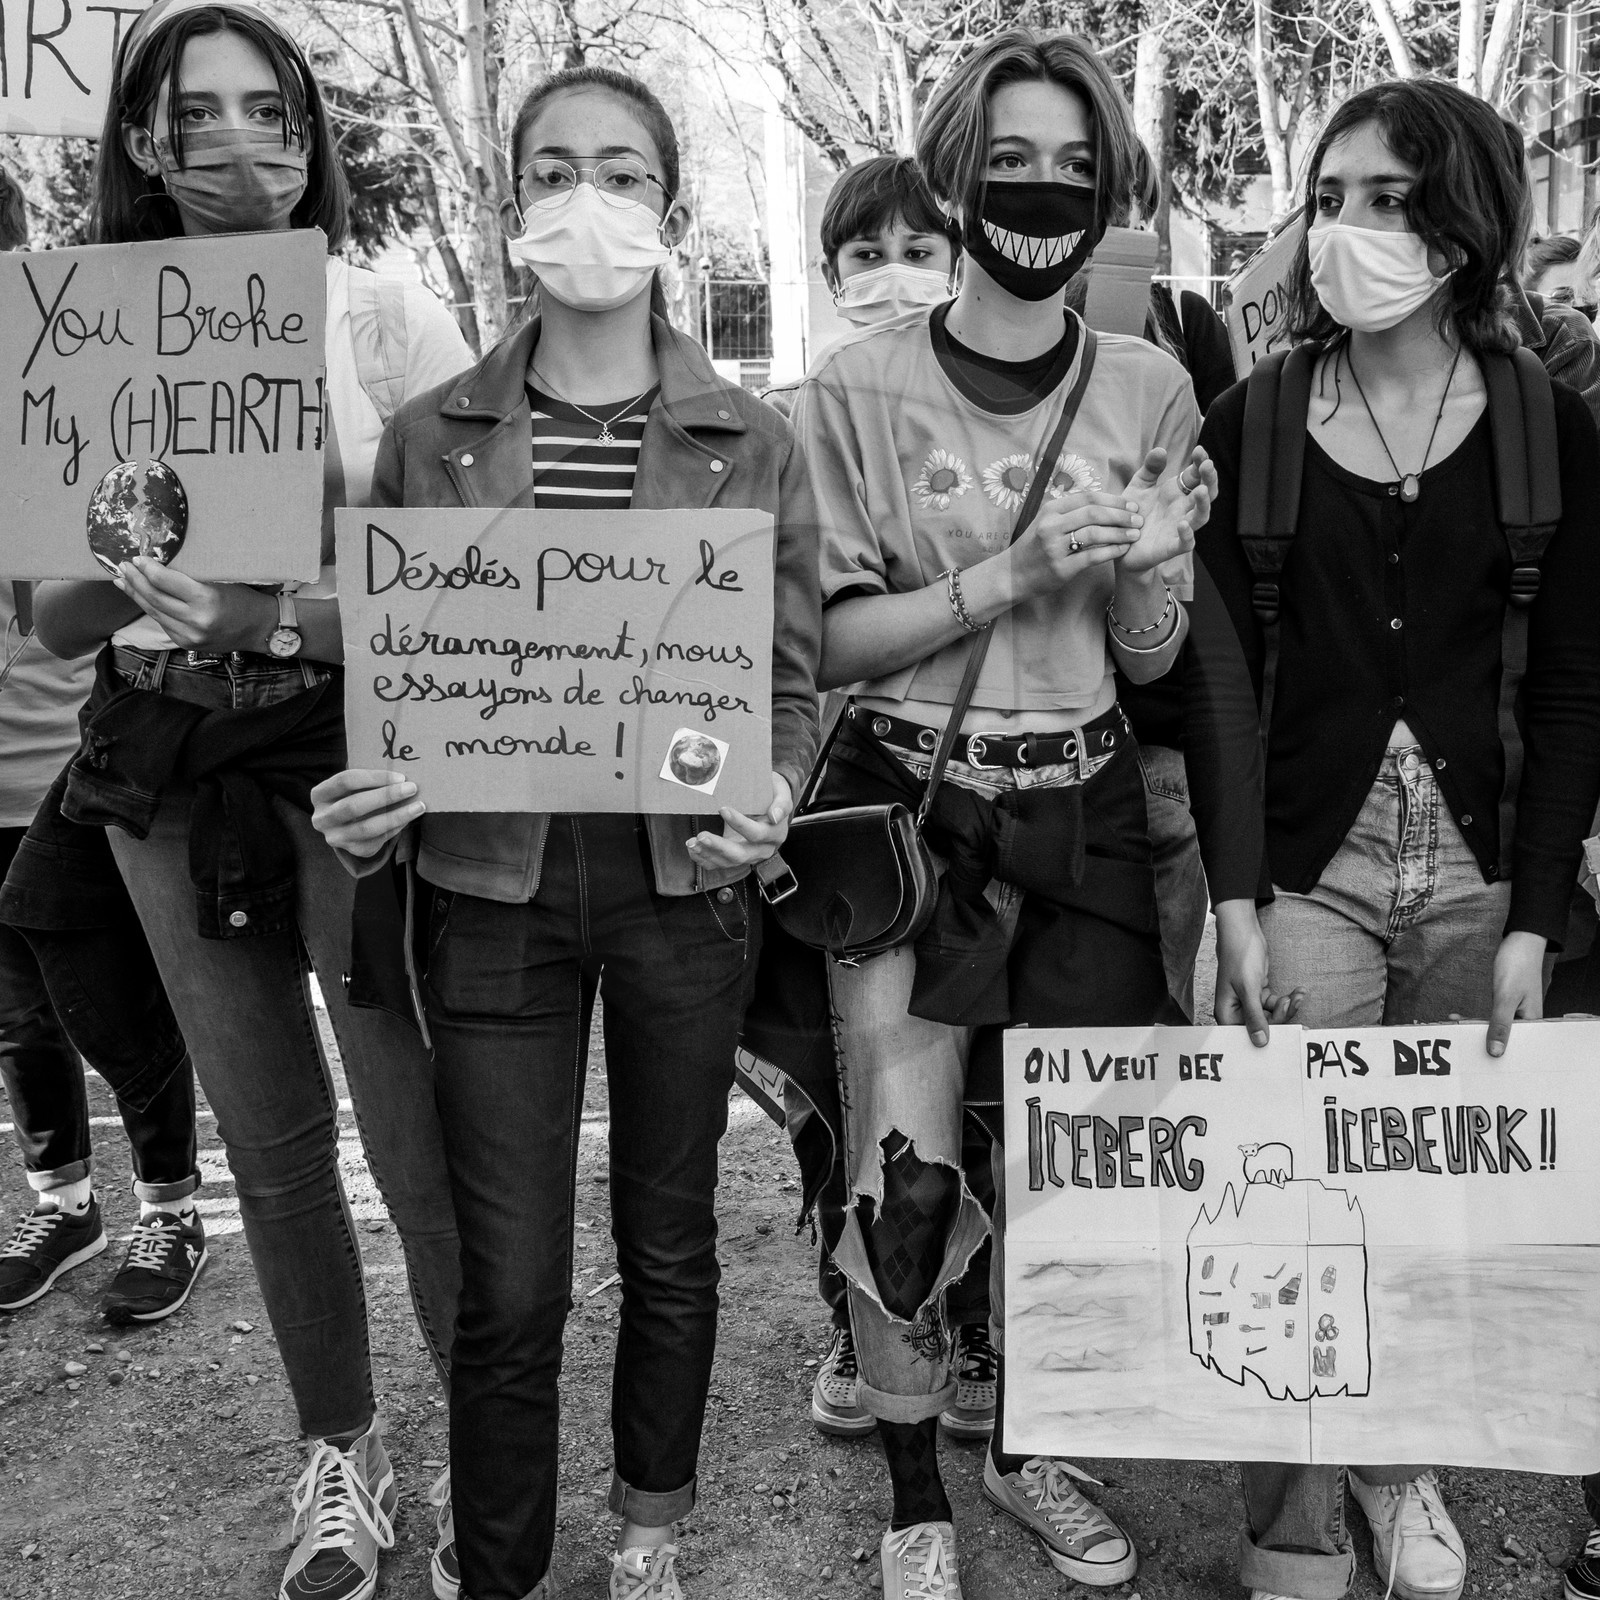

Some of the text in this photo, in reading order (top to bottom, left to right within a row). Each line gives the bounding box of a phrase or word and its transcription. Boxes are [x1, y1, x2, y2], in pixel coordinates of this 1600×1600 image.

[22, 262, 308, 379] You Broke
[22, 385, 89, 486] My
[948, 529, 972, 539] YOU
[978, 532, 999, 540] ARE
[367, 524, 743, 611] Désolés pour le
[657, 643, 753, 669] nous
[374, 669, 753, 721] essayons de changer
[382, 720, 420, 761] le
[446, 726, 596, 757] monde
[1024, 1048, 1223, 1084] ON VEUT DES
[1307, 1039, 1451, 1078] PAS DES
